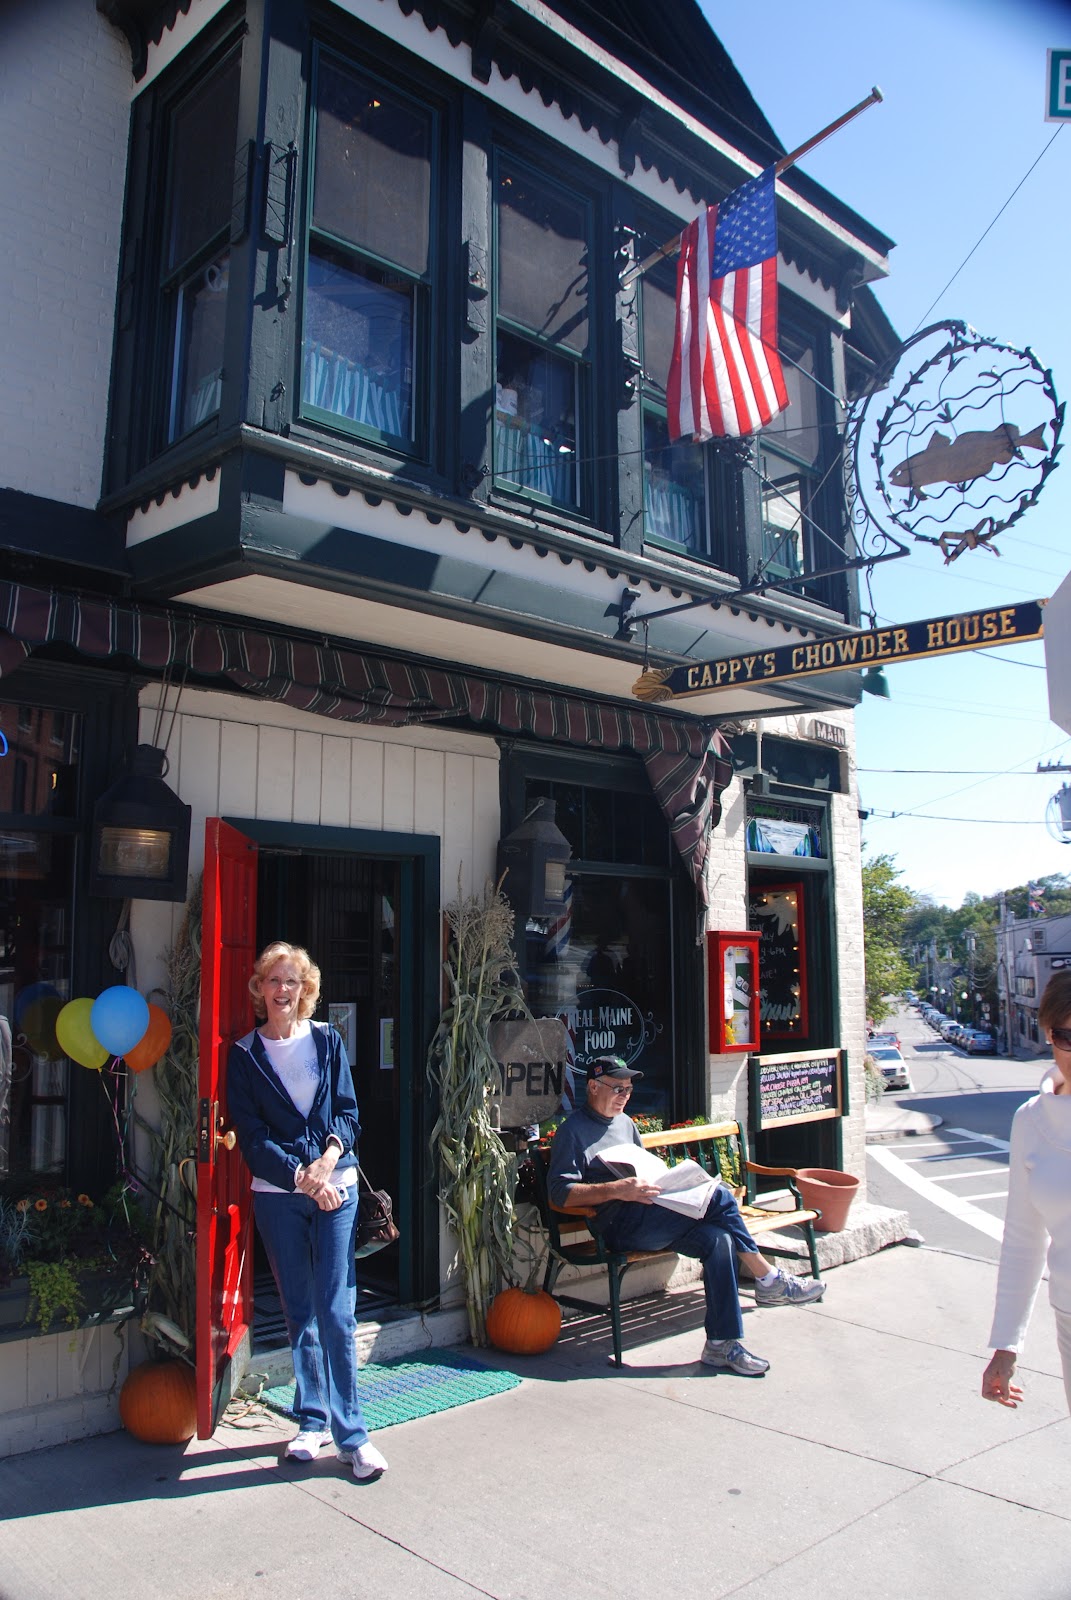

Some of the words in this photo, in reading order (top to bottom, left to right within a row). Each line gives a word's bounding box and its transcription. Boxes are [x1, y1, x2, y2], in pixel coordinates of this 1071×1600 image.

[687, 652, 775, 689] CAPPY'S
[792, 628, 909, 671] CHOWDER
[927, 608, 1016, 648] HOUSE
[817, 721, 845, 745] MAIN
[566, 1008, 595, 1034] REAL
[599, 1006, 633, 1031] MAINE
[584, 1029, 616, 1055] FOOD
